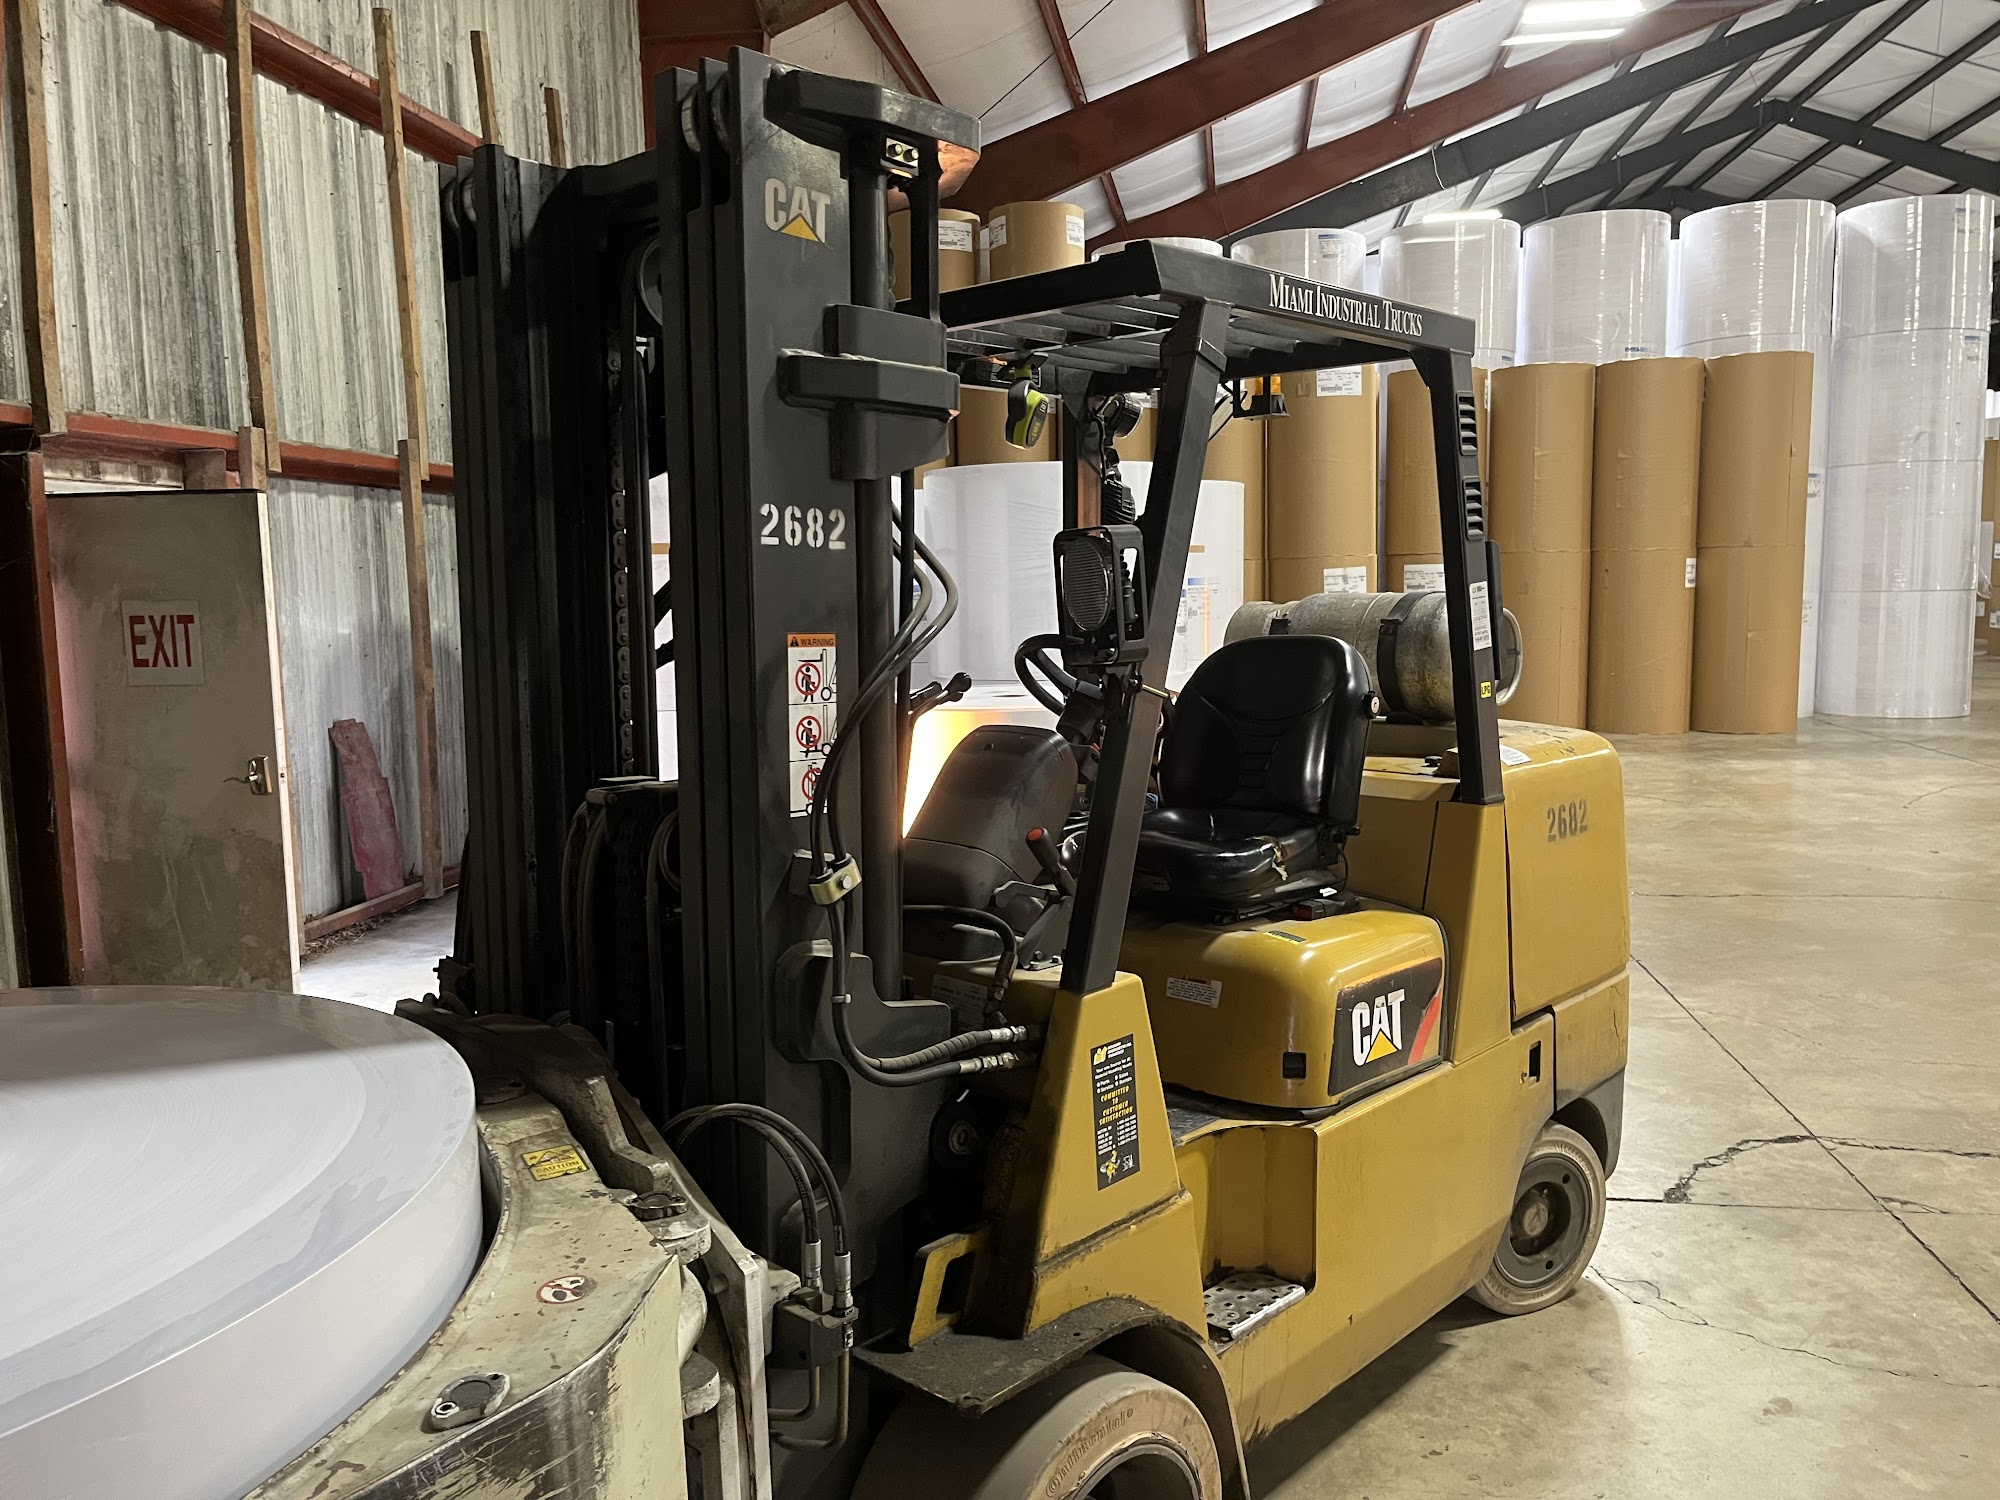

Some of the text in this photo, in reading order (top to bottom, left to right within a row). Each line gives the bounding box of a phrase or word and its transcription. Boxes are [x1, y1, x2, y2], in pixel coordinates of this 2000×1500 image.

[765, 178, 831, 244] CAT
[1269, 273, 1423, 337] MIAMI INDUSTRIAL TRUCKS
[760, 503, 846, 550] 2682
[129, 614, 194, 668] EXIT
[800, 638, 834, 646] WARNING
[1481, 685, 1491, 695] LPG
[1547, 799, 1588, 843] 2682
[1352, 988, 1405, 1066] CAT
[536, 1161, 580, 1173] CAUTION
